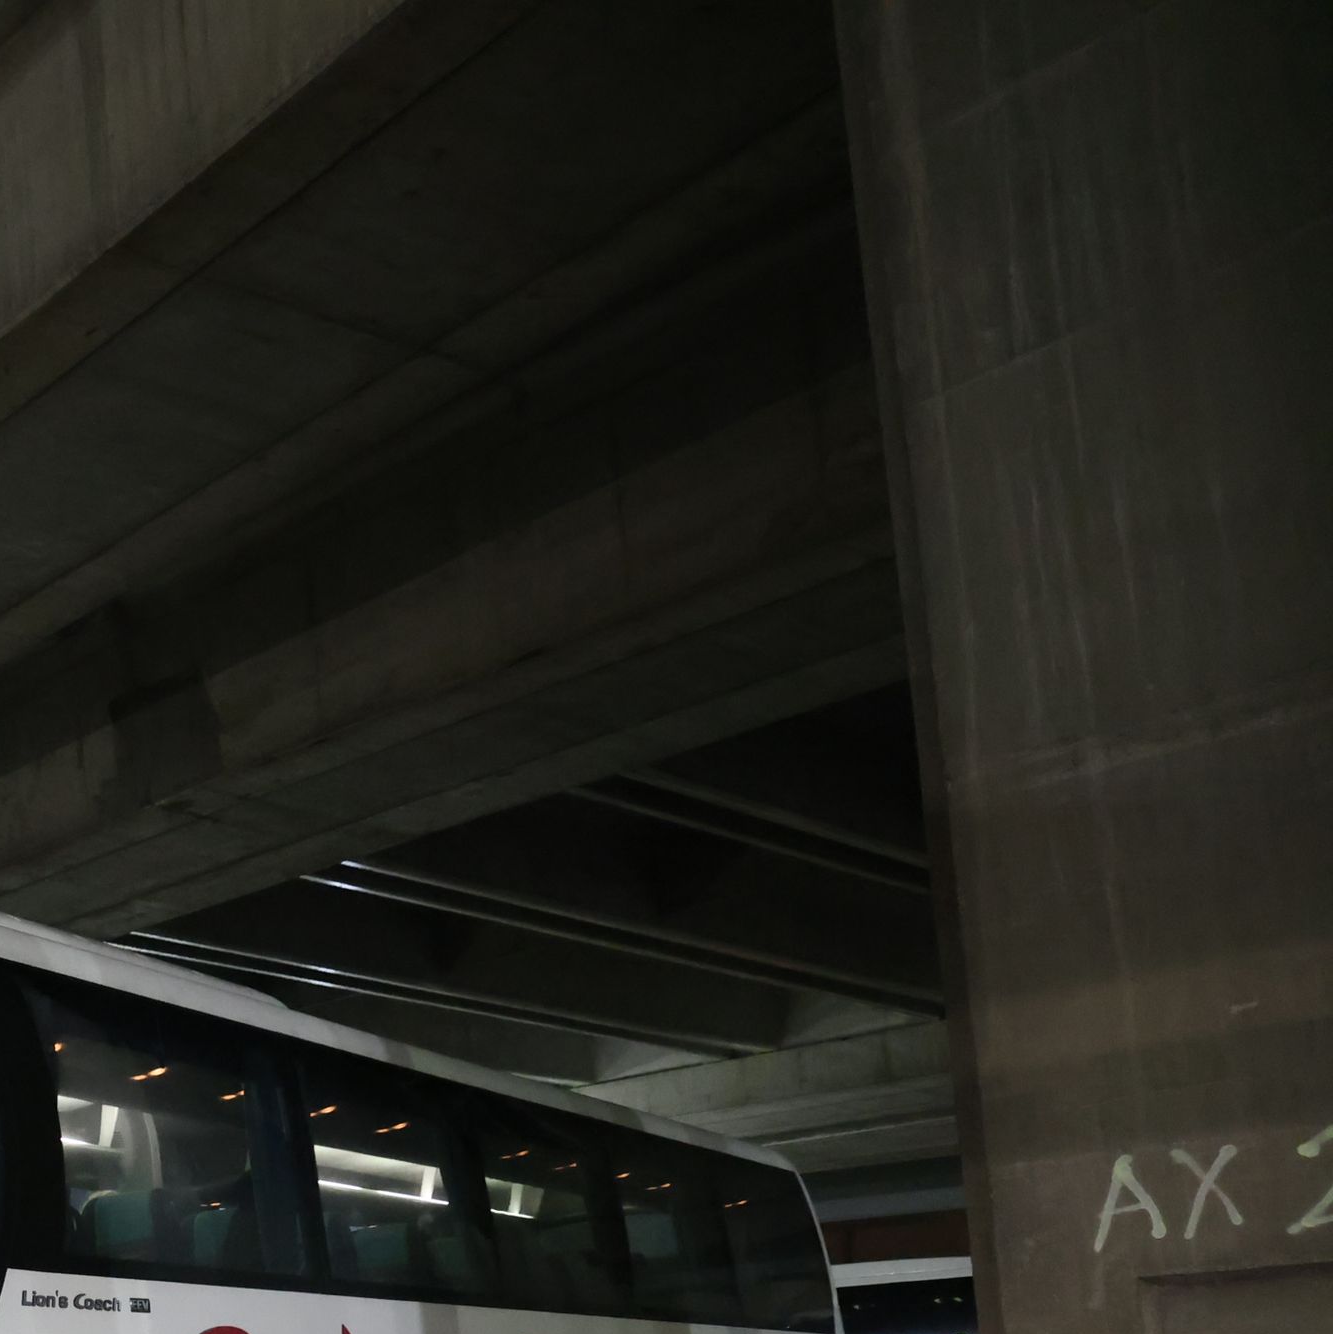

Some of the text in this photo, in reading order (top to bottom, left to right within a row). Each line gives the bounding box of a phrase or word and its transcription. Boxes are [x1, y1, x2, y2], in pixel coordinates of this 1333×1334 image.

[1094, 1144, 1244, 1253] AX
[21, 1290, 69, 1309] Lion's
[73, 1293, 121, 1312] Coach
